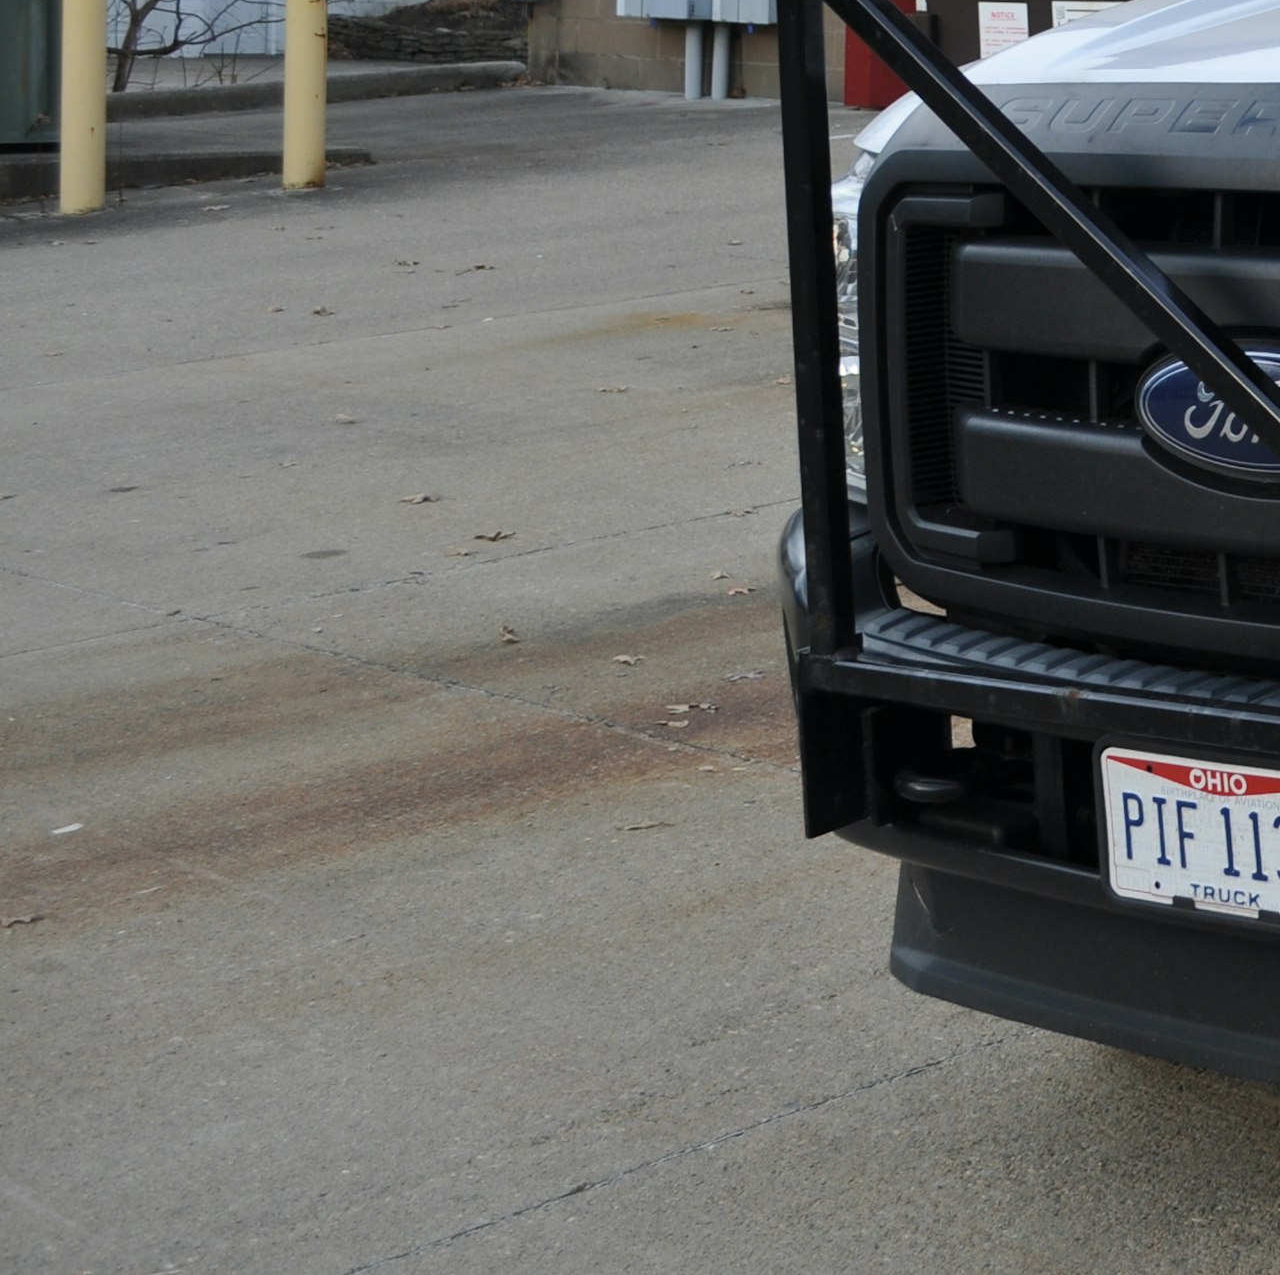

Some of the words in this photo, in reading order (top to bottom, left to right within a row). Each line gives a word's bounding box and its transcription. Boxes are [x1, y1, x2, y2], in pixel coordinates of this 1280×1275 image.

[1188, 767, 1248, 796] OHIO
[1234, 795, 1280, 812] AVIATION
[1122, 791, 1199, 869] PIF
[1190, 882, 1261, 908] TRUCK
